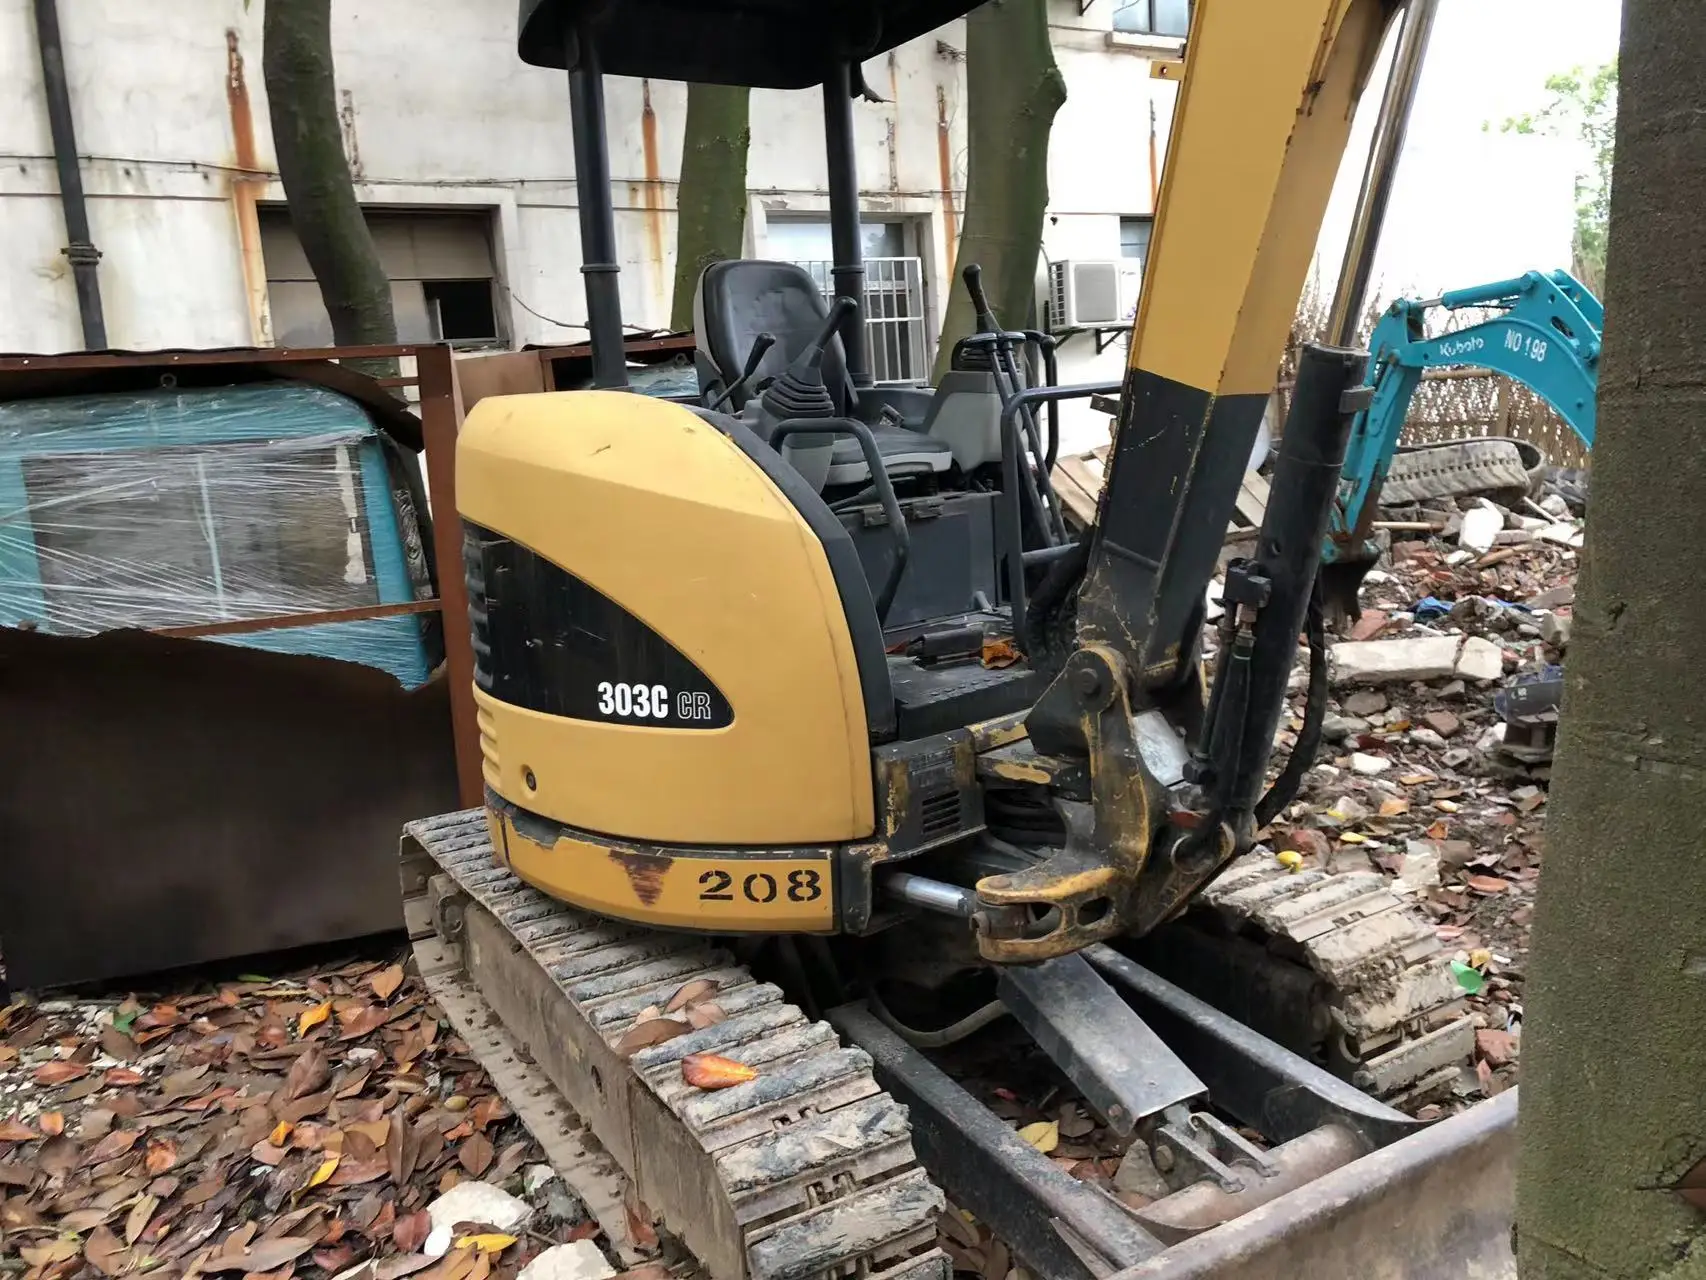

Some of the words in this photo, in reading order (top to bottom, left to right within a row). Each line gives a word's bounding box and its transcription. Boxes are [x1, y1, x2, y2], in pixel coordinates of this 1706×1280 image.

[1504, 328, 1521, 352] NO
[1524, 336, 1547, 362] 198
[598, 681, 669, 718] 303C
[677, 691, 712, 719] CR
[699, 869, 821, 903] 208
